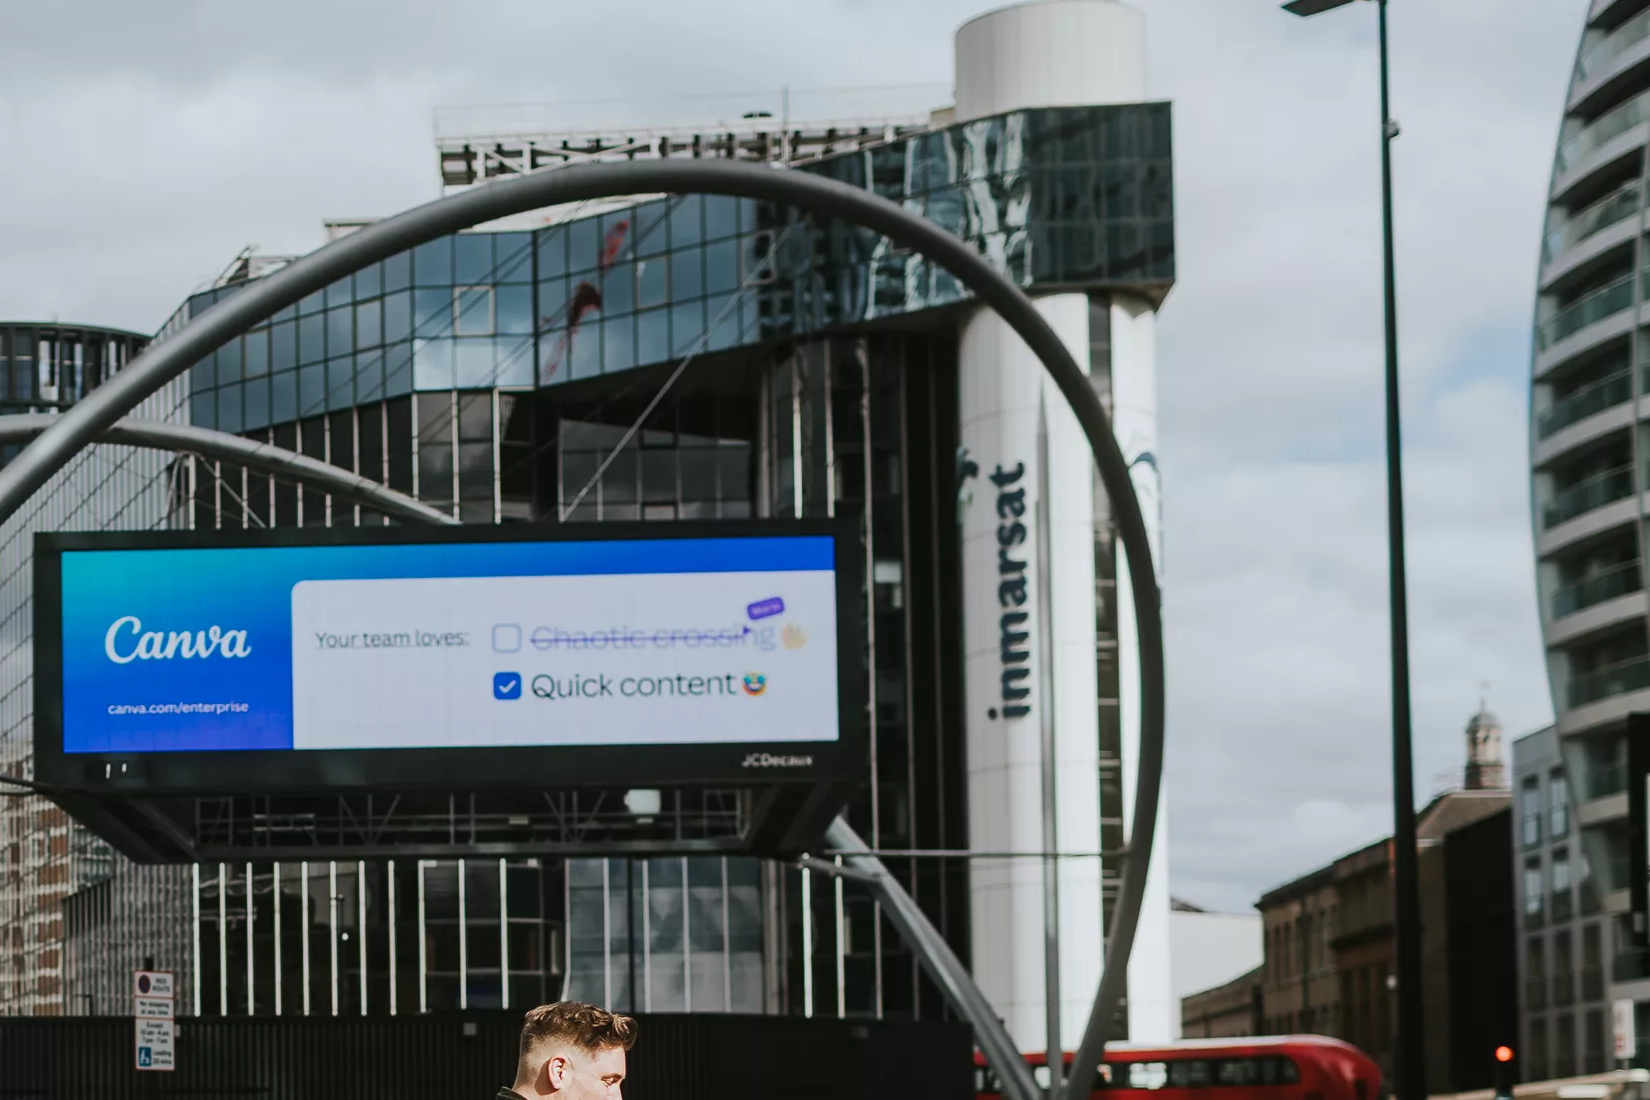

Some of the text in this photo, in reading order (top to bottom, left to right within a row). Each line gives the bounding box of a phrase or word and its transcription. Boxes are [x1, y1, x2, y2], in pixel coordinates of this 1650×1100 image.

[987, 460, 1031, 721] inmarsat
[104, 615, 252, 664] Canva
[315, 628, 470, 648] Your team loves:
[531, 622, 776, 652] Chaotic crossing
[531, 672, 738, 700] Quick content
[107, 701, 249, 715] canva.com/enterprise
